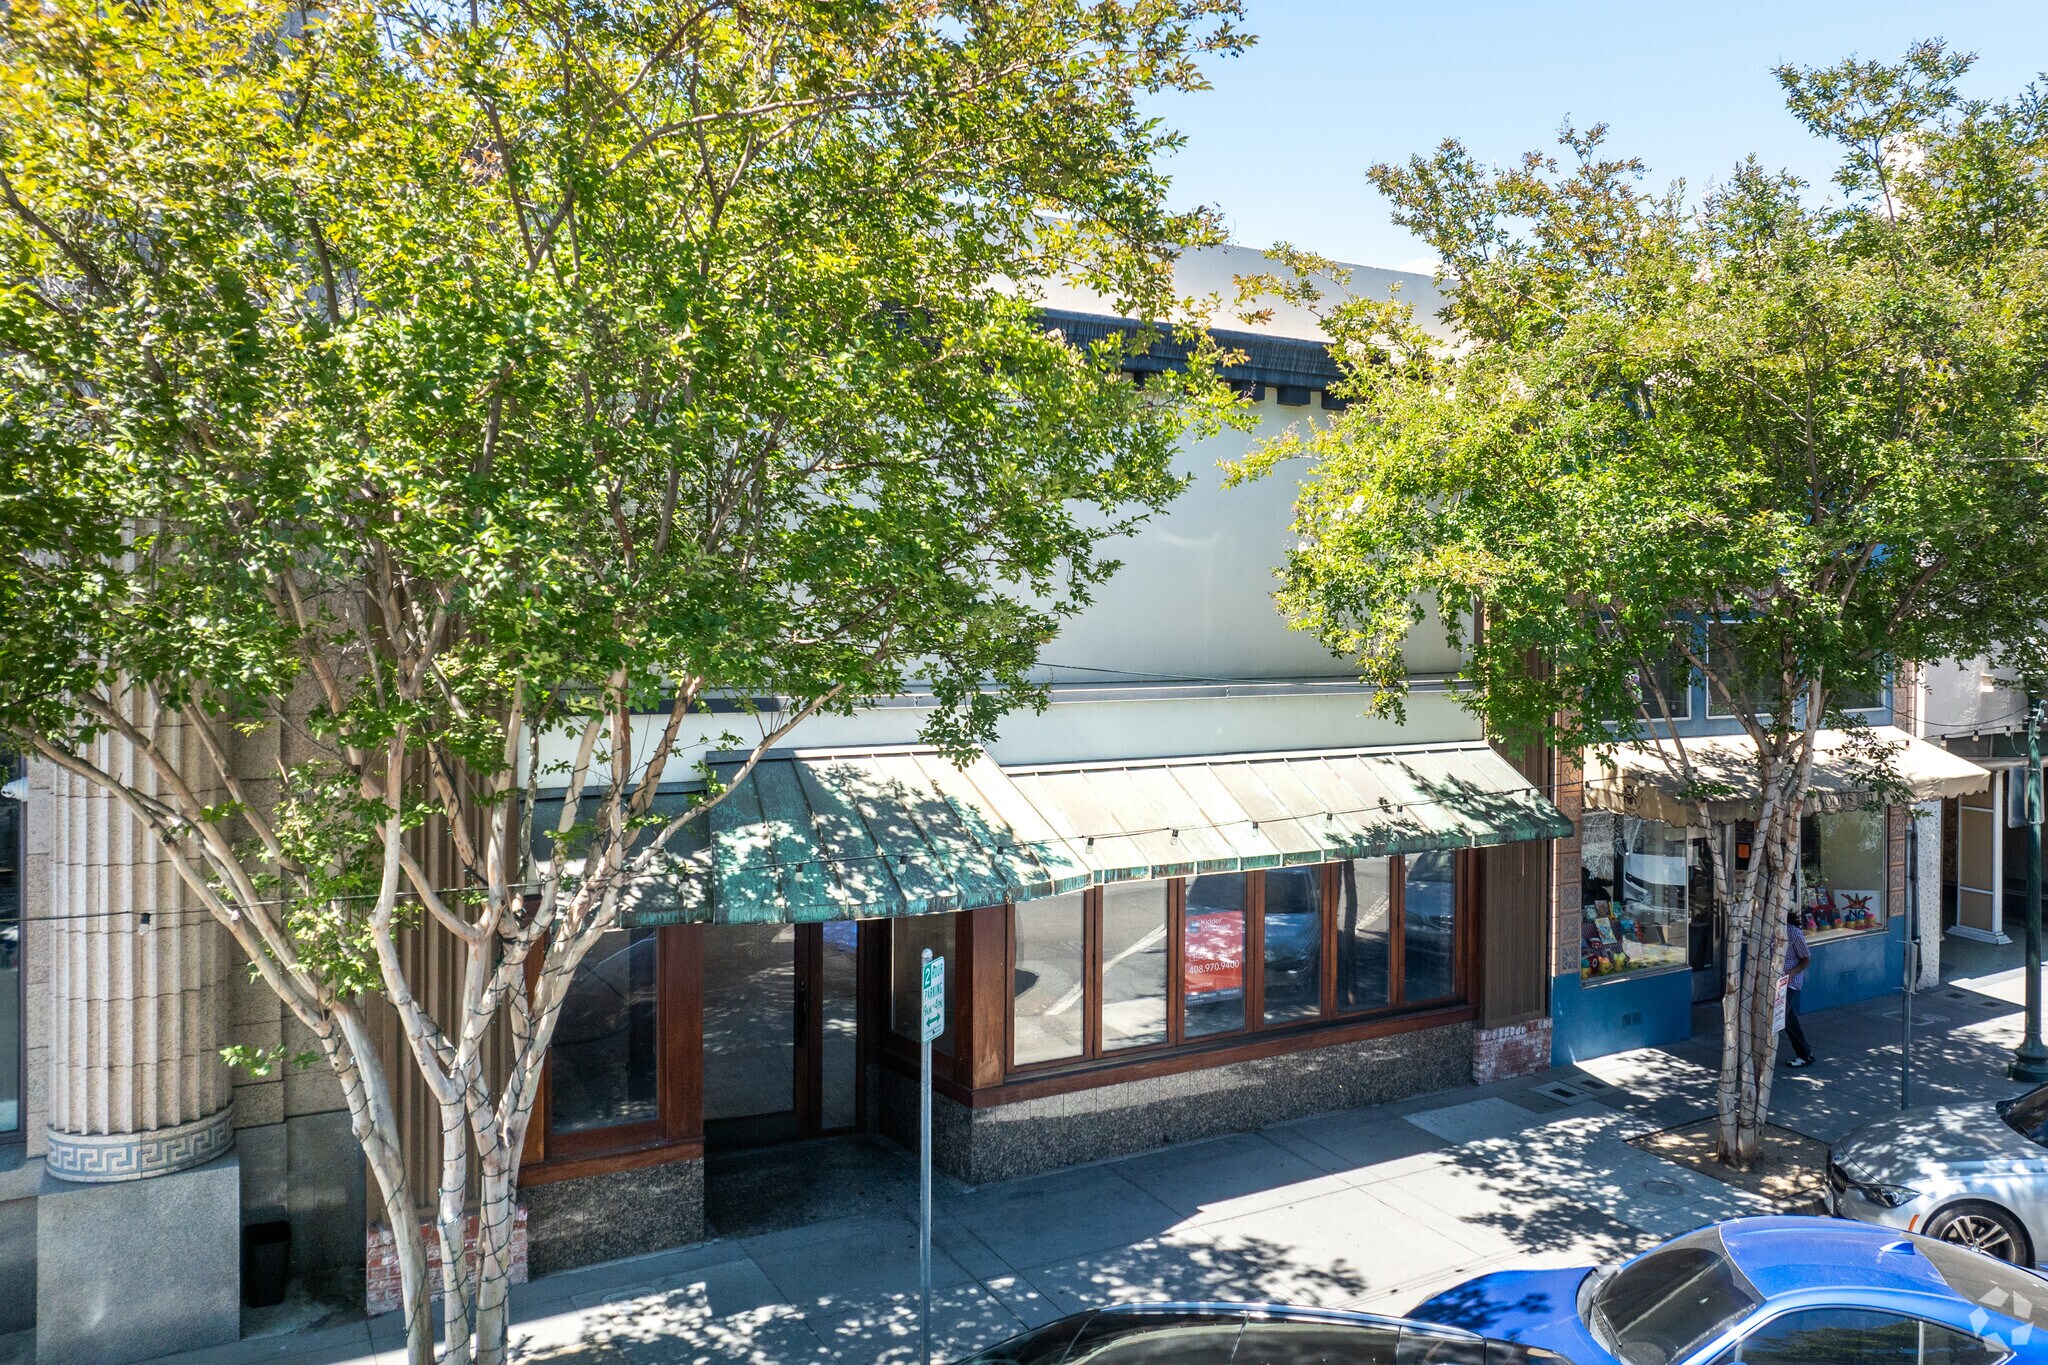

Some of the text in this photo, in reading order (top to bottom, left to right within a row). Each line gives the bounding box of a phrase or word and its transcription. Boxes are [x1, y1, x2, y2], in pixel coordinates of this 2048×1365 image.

[1849, 909, 1867, 918] NO
[1200, 918, 1222, 926] Kidder
[1189, 959, 1240, 974] 408.970.9400
[925, 967, 931, 985] 2
[925, 982, 943, 1002] PARKING
